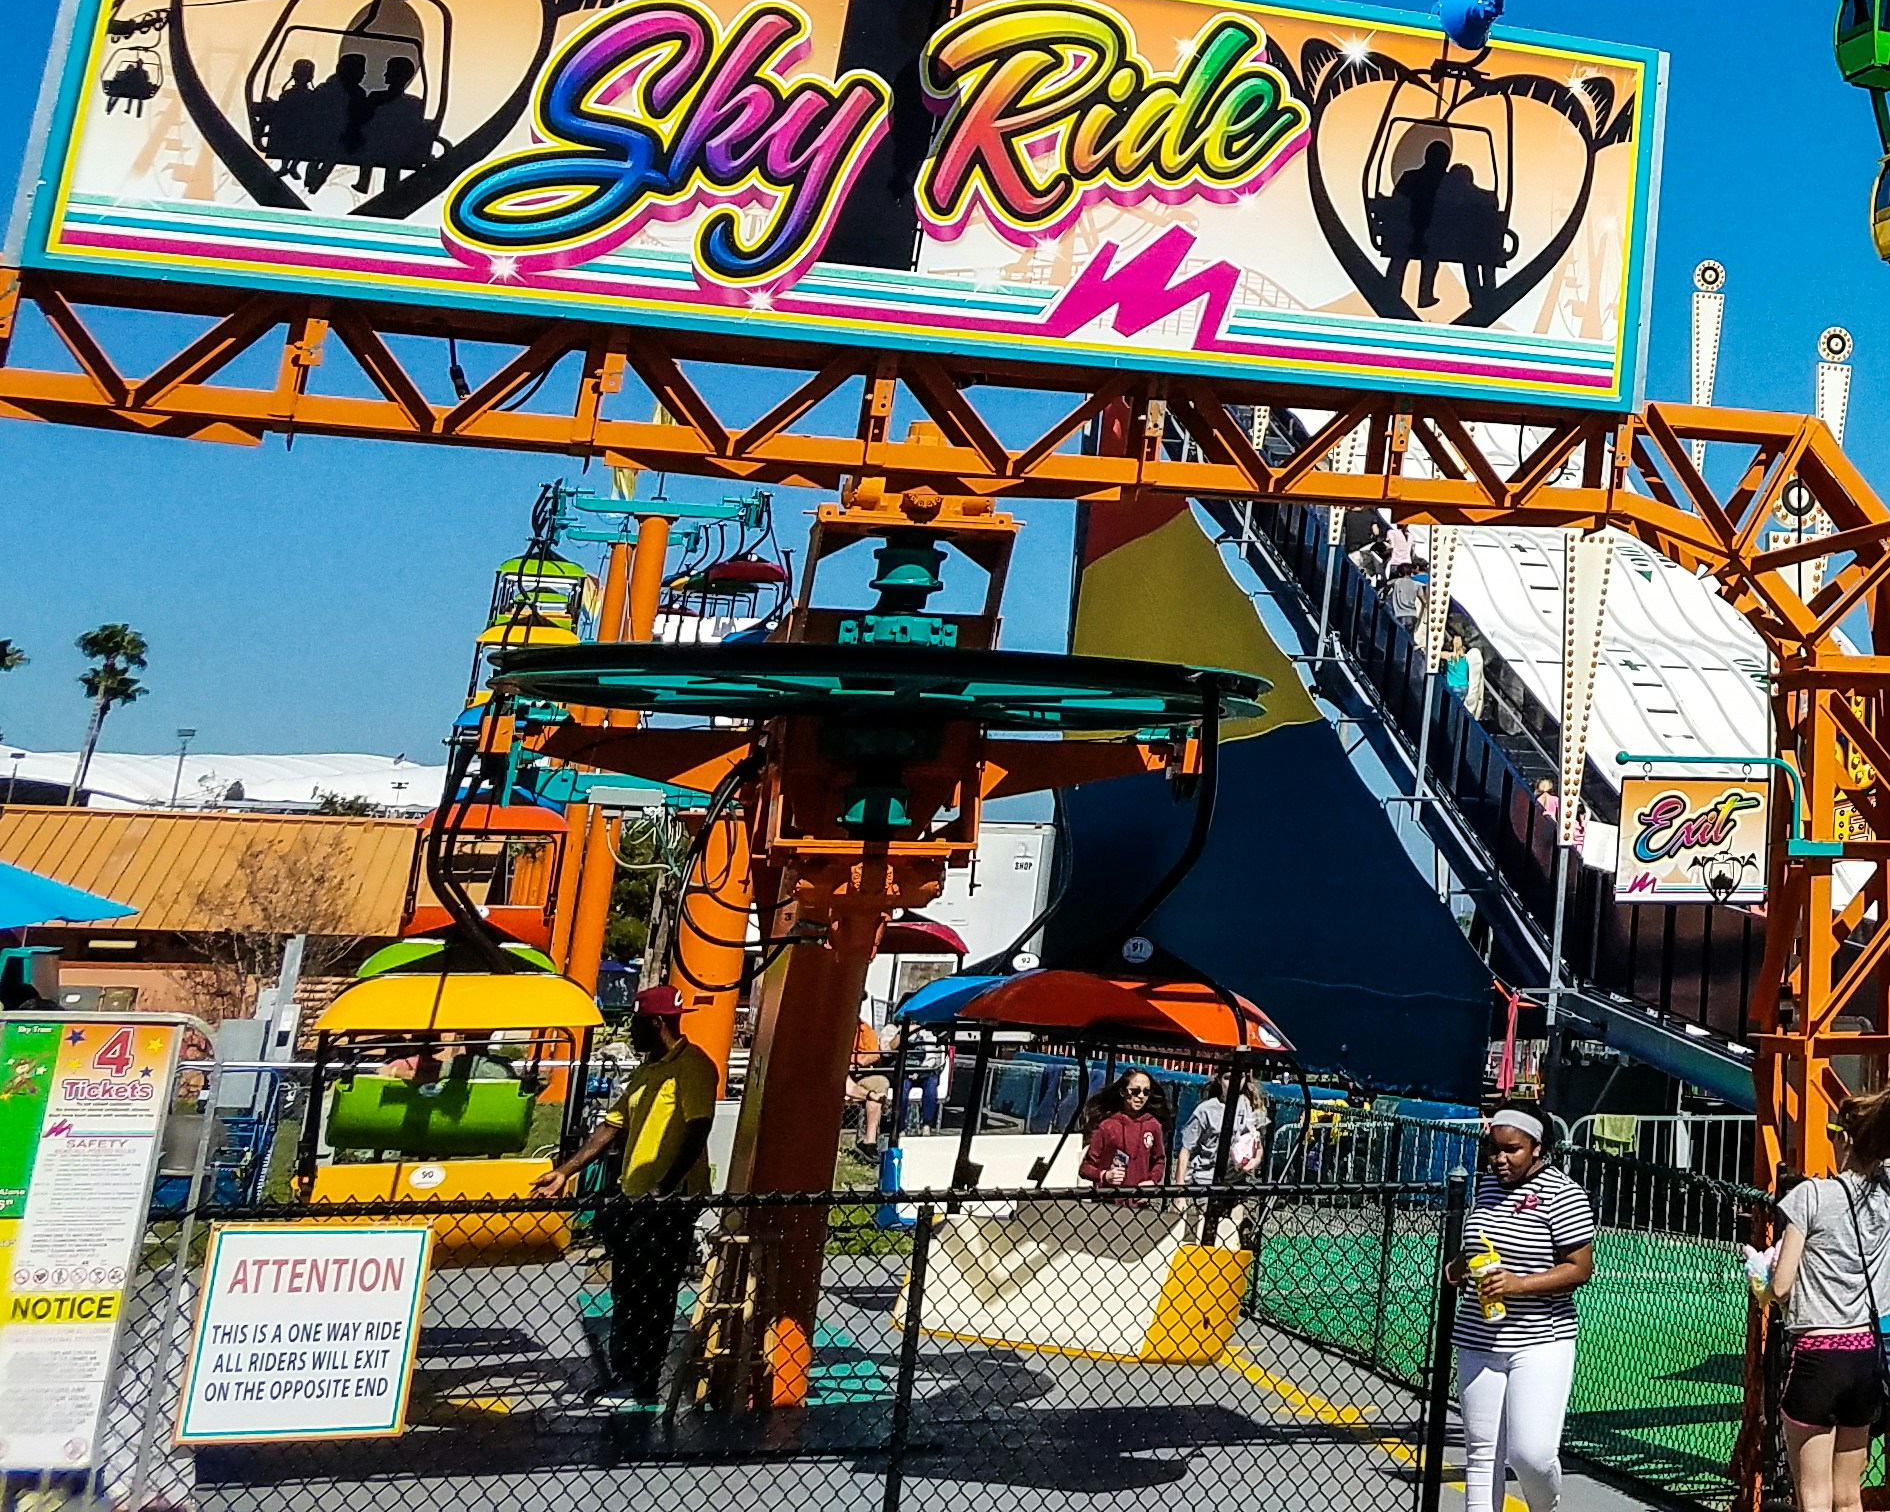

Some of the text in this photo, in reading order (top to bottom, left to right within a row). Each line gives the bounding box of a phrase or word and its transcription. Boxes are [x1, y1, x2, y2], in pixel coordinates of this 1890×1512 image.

[1633, 792, 1760, 863] Exit
[1014, 861, 1033, 871] SHOP
[1131, 941, 1144, 953] 91
[93, 1026, 134, 1077] 4
[62, 1078, 153, 1101] Tickets
[66, 1139, 129, 1148] SAFETY
[228, 1257, 405, 1294] ATTENTION
[11, 1296, 115, 1320] NOTICE
[212, 1321, 402, 1344] THIS IS A ONE WAY RIDE
[212, 1349, 391, 1373] ALL RIDERS WILL EXIT
[204, 1377, 389, 1402] ON THE OPPOSITE END
